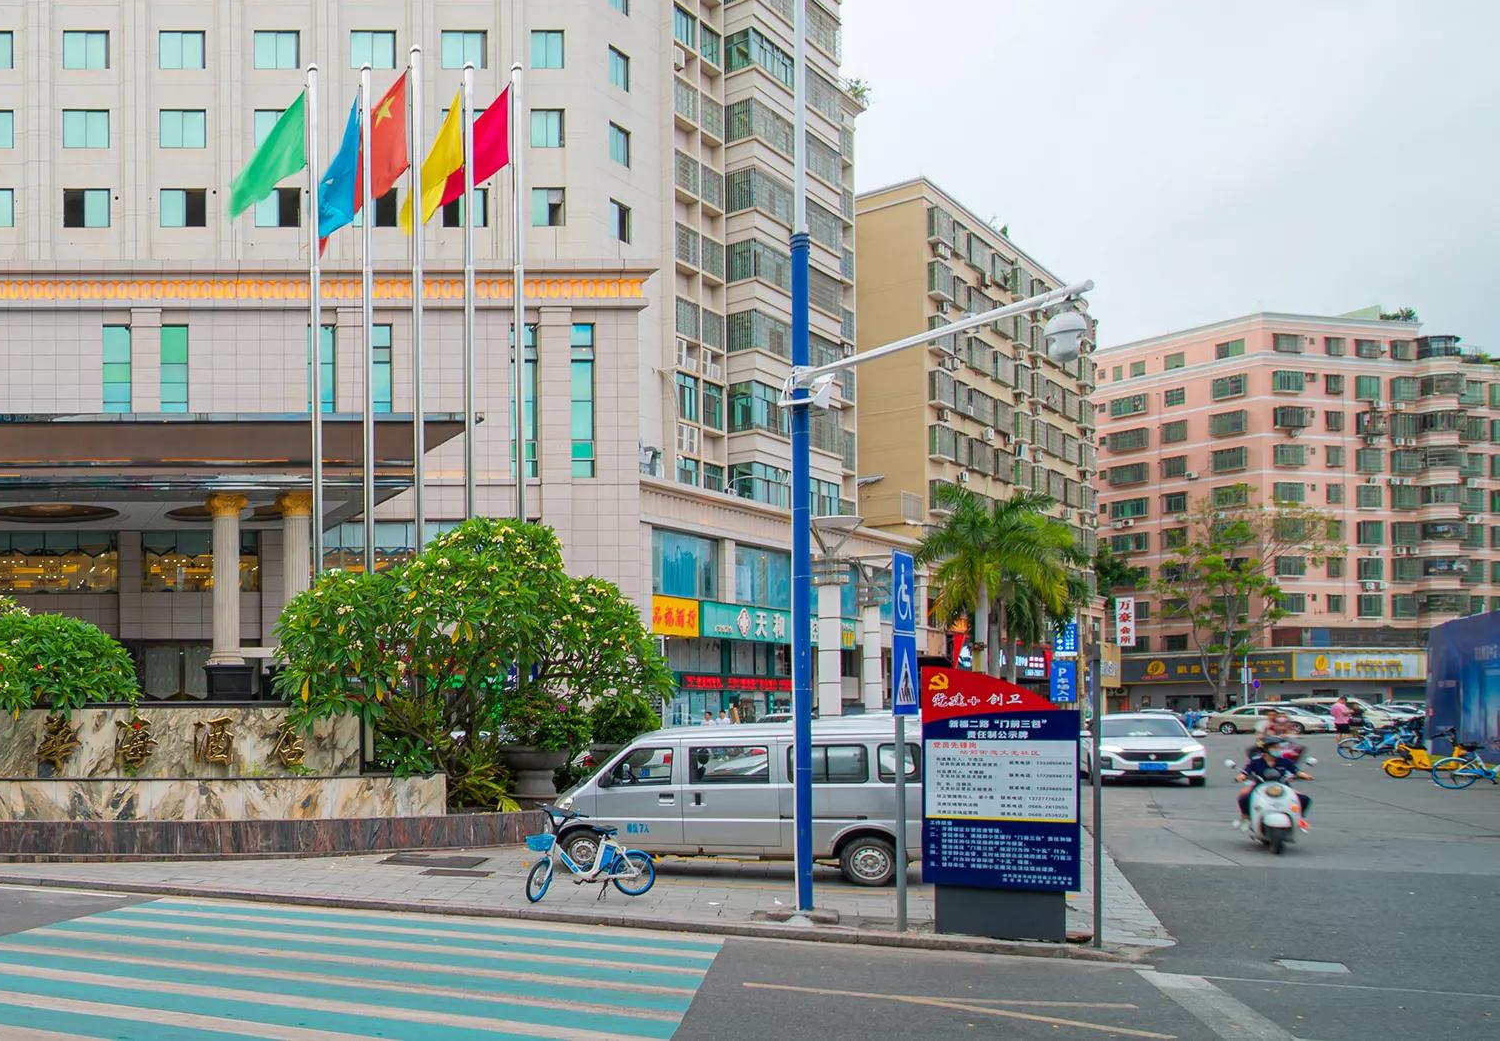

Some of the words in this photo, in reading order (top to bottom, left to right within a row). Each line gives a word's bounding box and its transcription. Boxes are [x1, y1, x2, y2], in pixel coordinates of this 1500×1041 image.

[1118, 601, 1132, 644] 万豪会所
[1058, 667, 1067, 676] P
[986, 693, 1024, 706] 创卫
[966, 730, 1029, 739] 责任制公示牌
